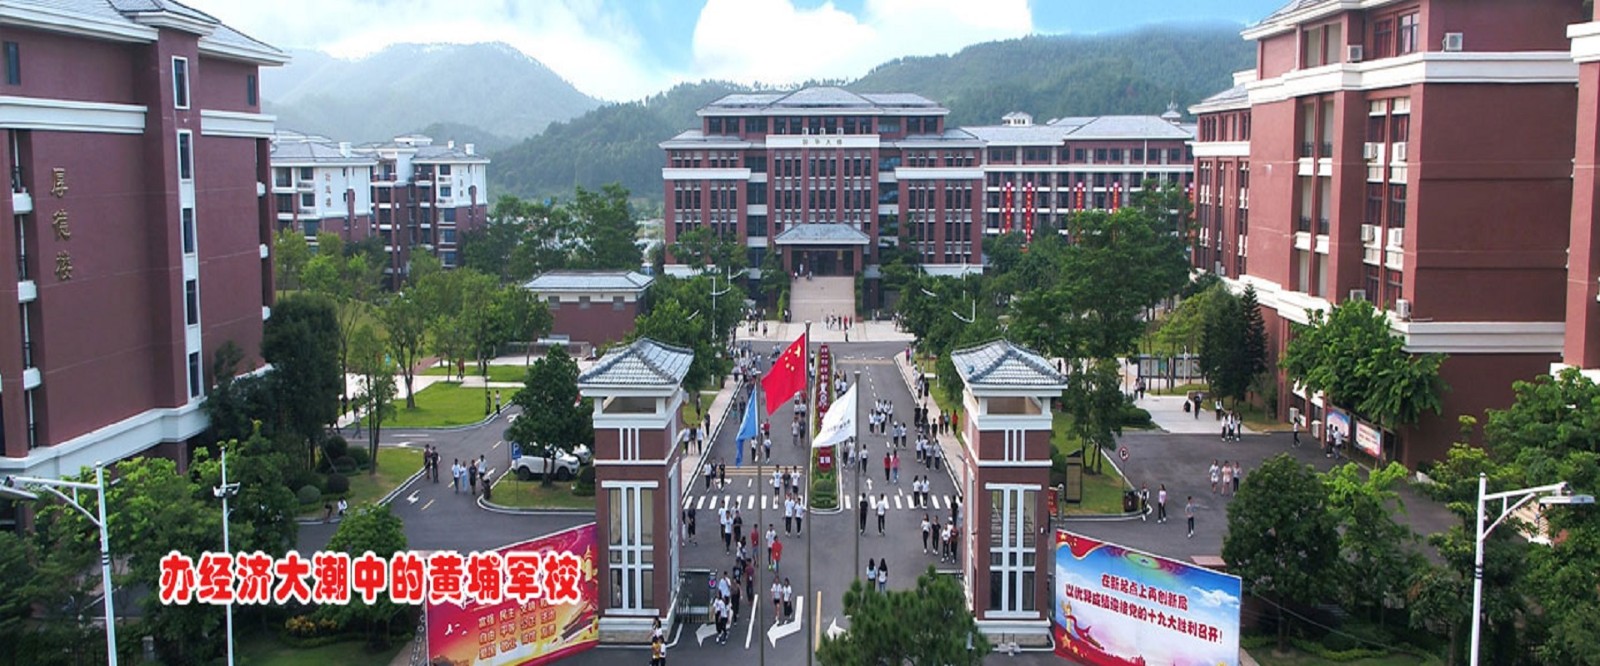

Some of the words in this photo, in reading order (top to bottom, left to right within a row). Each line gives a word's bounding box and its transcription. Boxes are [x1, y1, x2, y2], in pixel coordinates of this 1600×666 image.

[50, 167, 73, 281] 厚德楼
[1101, 573, 1188, 612] 在新起点上再创新局
[499, 607, 515, 622] 民主
[479, 630, 496, 644] 自由
[500, 622, 516, 637] 平等
